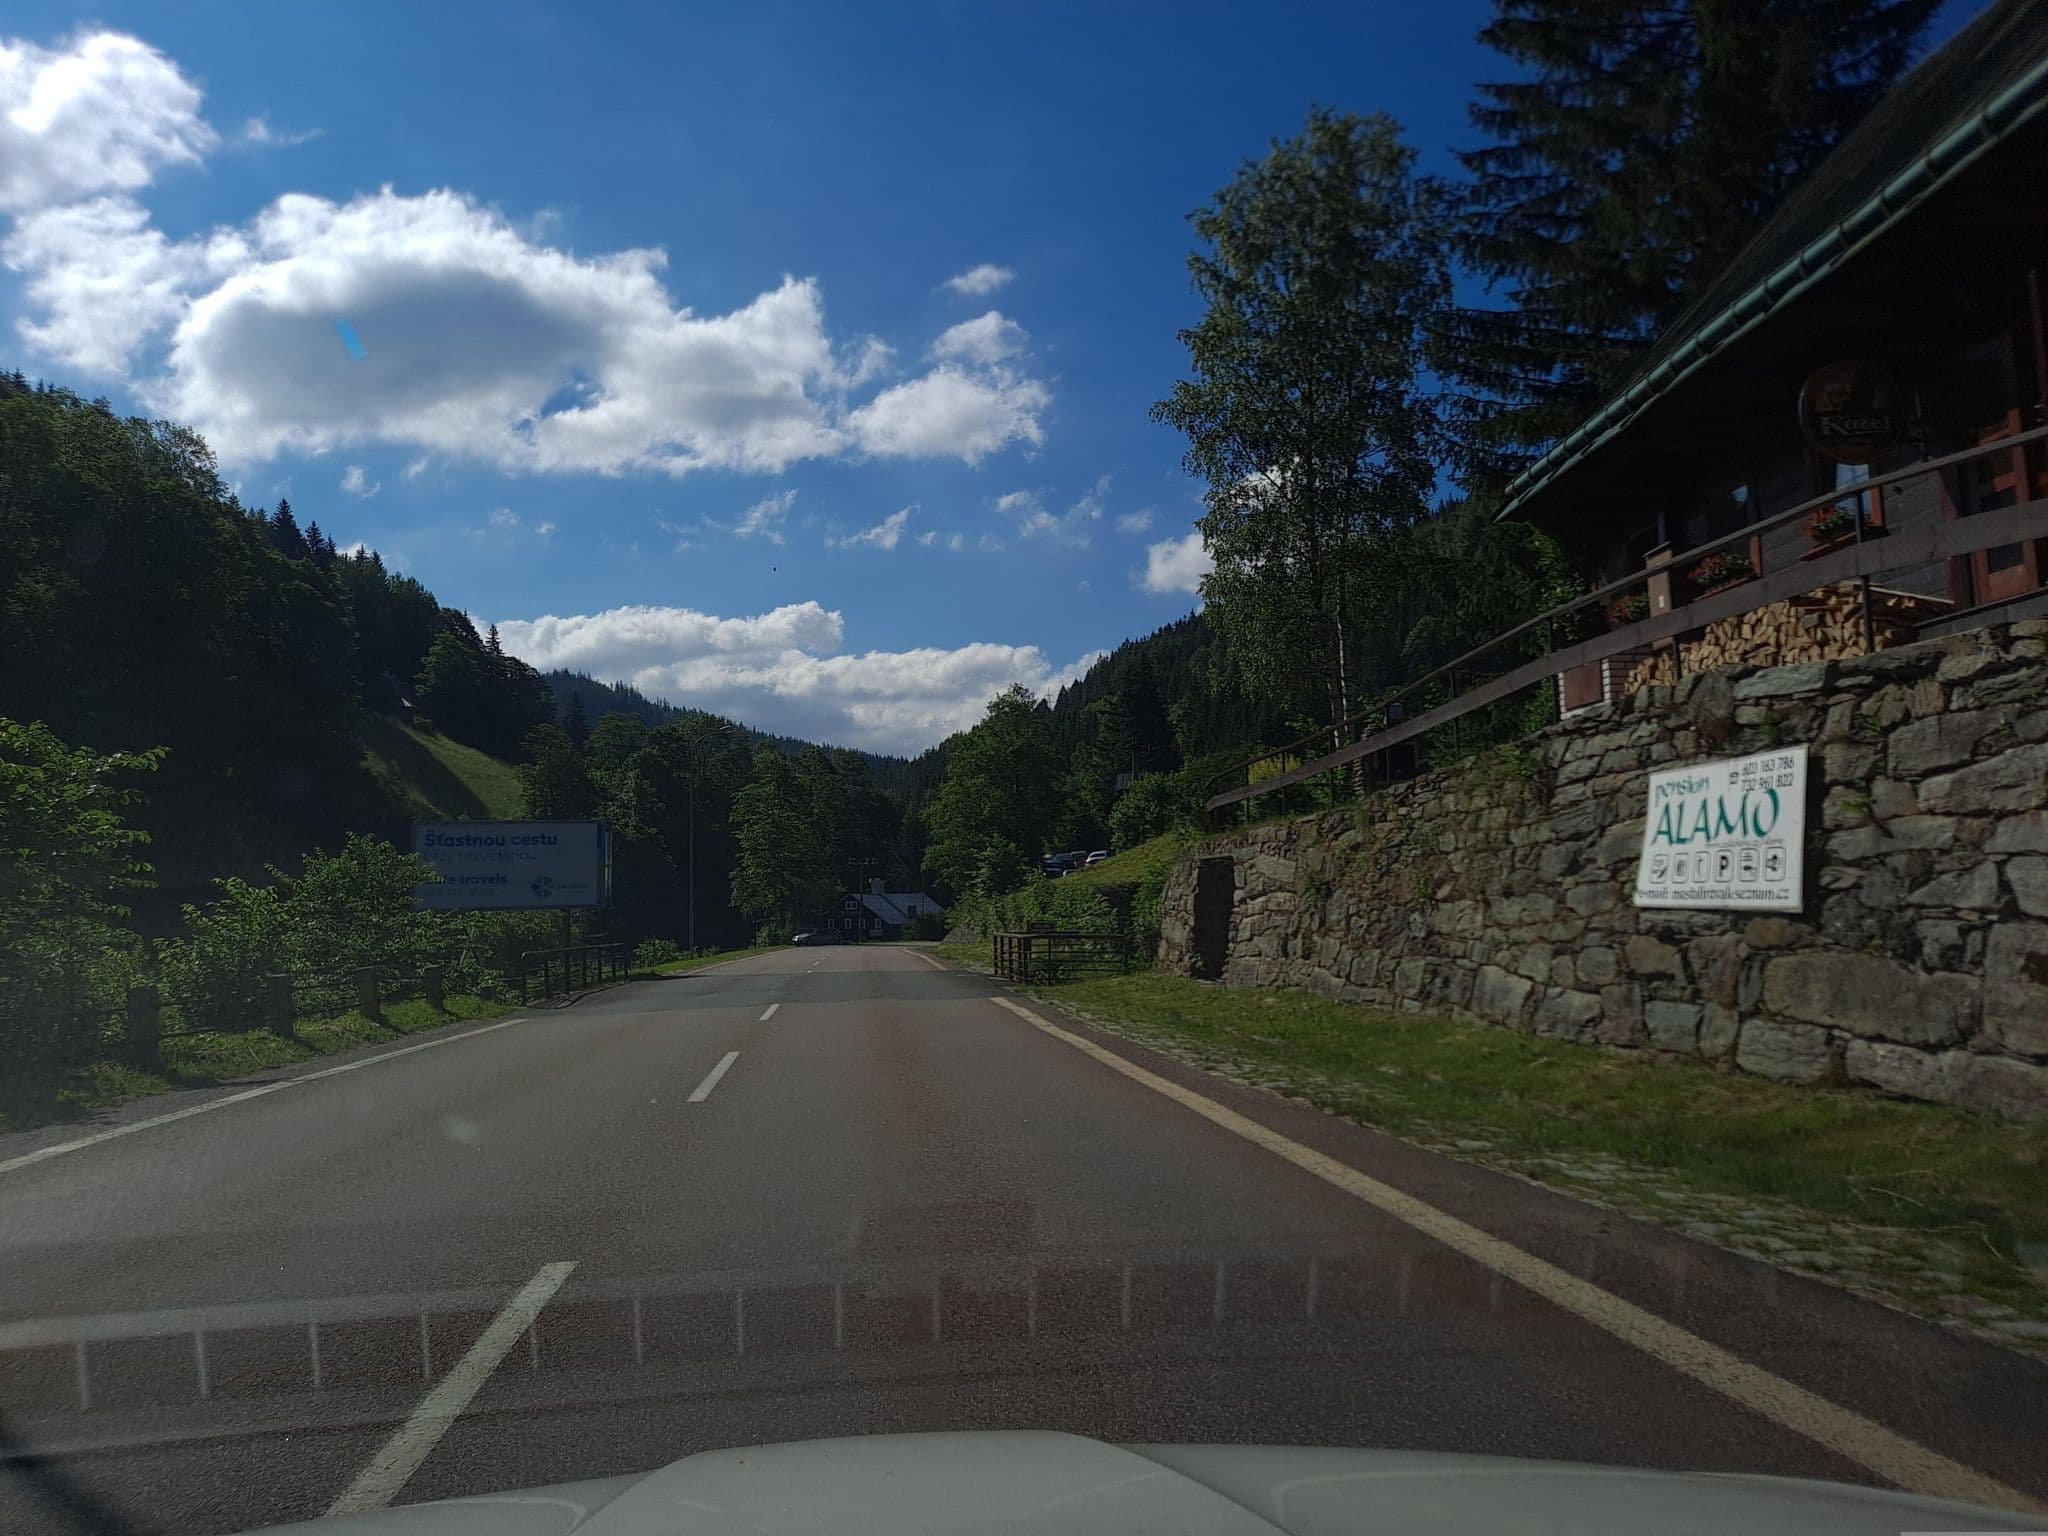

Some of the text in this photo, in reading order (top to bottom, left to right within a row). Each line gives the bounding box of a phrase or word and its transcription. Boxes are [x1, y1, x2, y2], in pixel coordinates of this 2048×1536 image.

[1819, 416, 1889, 436] Kozel
[1654, 775, 1710, 807] pension
[1651, 788, 1780, 845] ALAMO
[424, 829, 558, 847] Šťastnou cestu
[460, 872, 508, 885] travels
